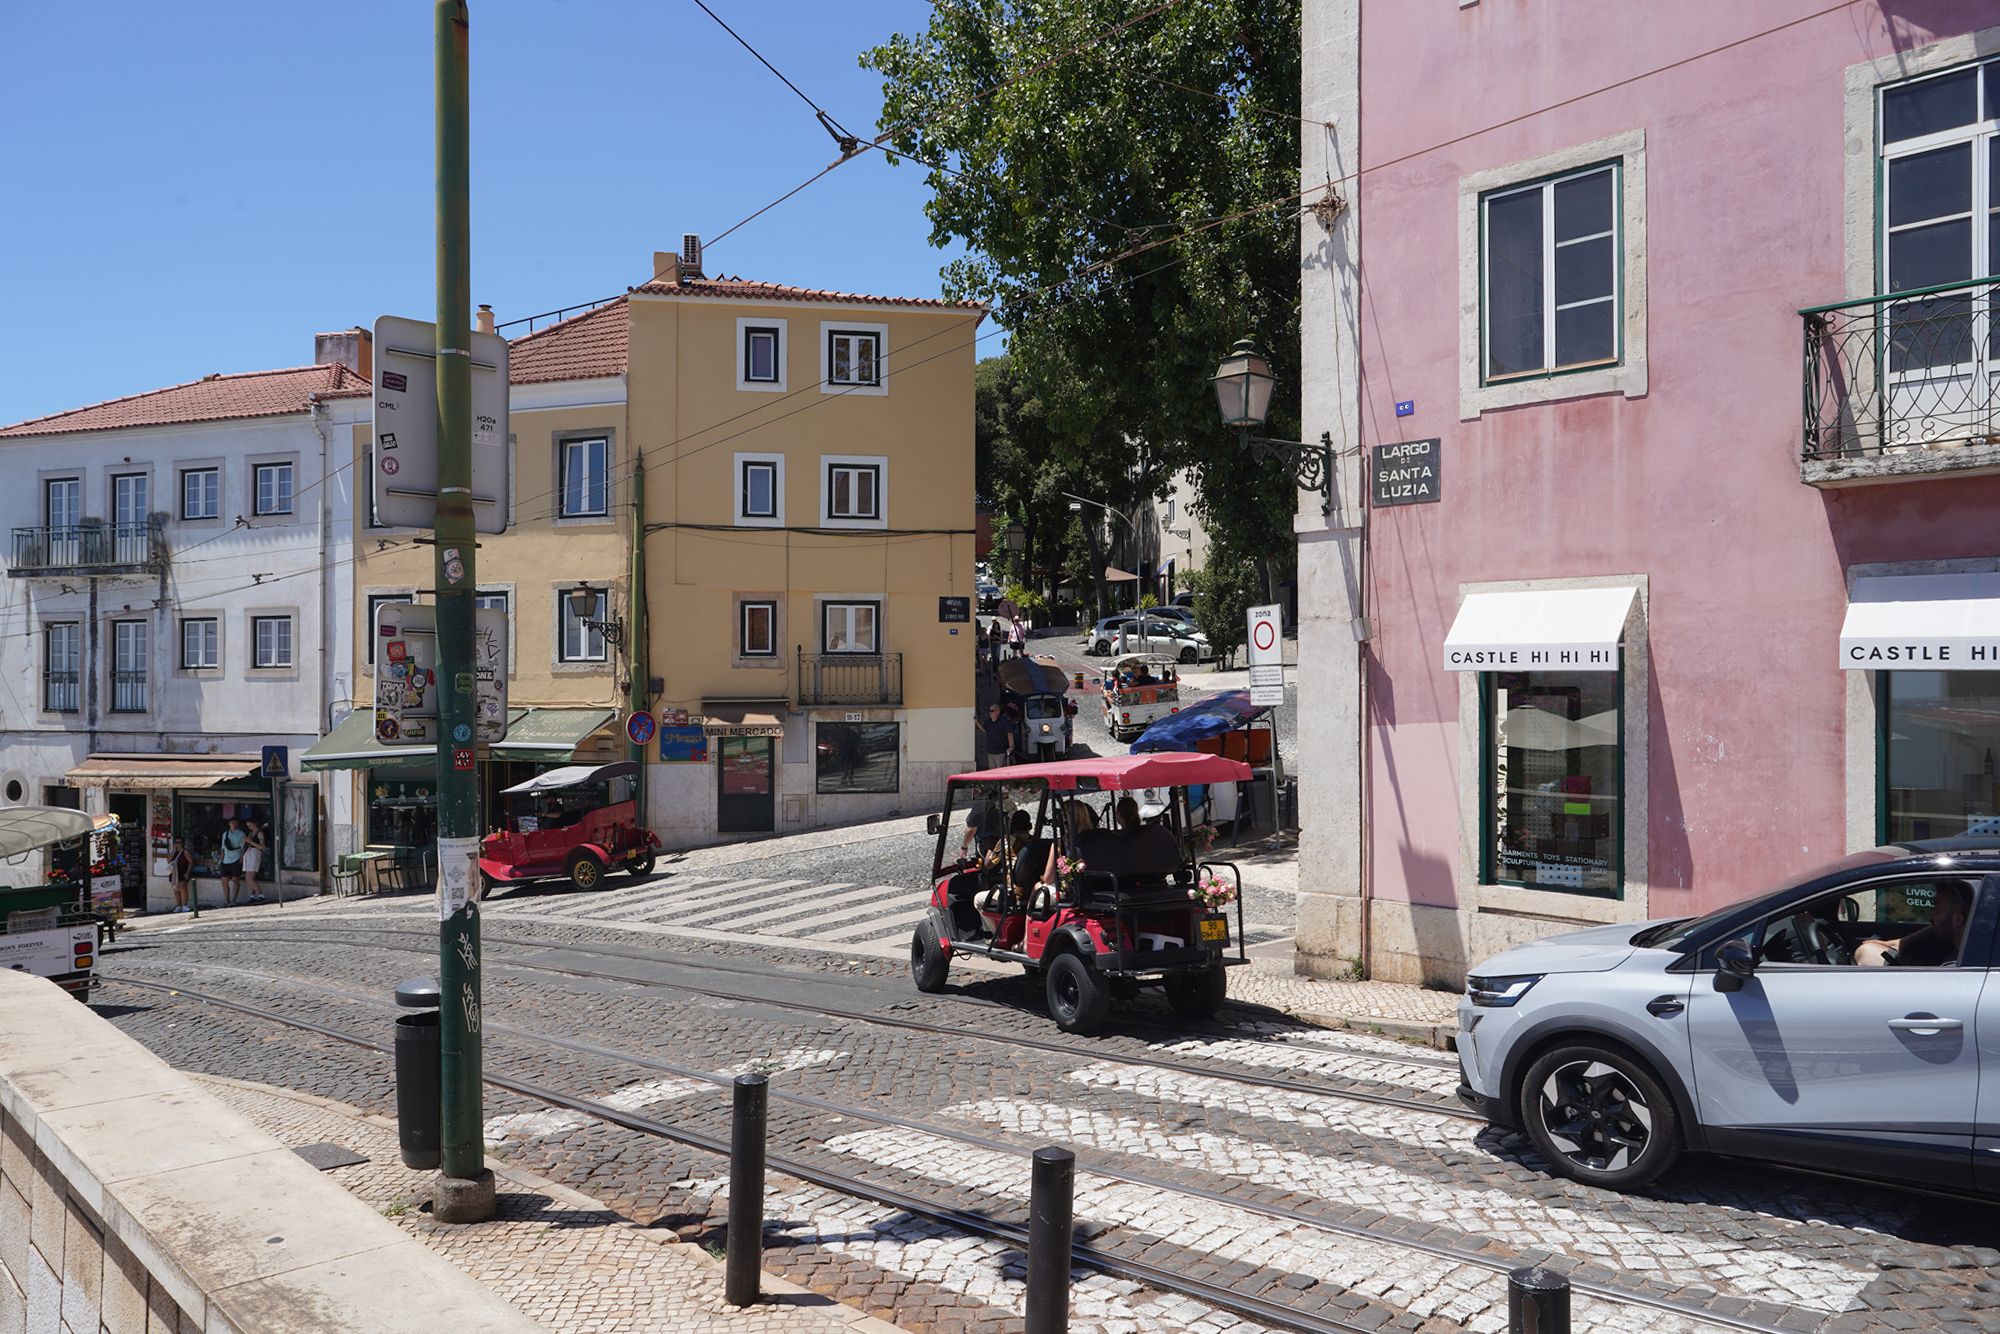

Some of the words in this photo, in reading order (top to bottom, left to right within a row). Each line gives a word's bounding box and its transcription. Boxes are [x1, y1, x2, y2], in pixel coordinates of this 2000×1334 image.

[379, 401, 397, 411] CML
[1381, 442, 1430, 459] LARGO
[1379, 466, 1432, 482] SANTA
[1381, 483, 1430, 498] LUZIA
[1255, 610, 1272, 618] zona
[1451, 651, 1518, 664] CASTLE
[1531, 651, 1549, 663] HI
[1560, 650, 1579, 663] HI
[1590, 650, 1609, 663] HI
[1851, 646, 1950, 660] CASTLE
[1971, 646, 1998, 660] HI
[705, 727, 727, 736] MINI
[729, 727, 782, 736] MERCADO
[1502, 849, 1538, 859] GARMENTS
[1543, 853, 1561, 861] TOYS
[1565, 855, 1609, 867] STATIONARY
[1906, 888, 1937, 898] LIVRO
[1905, 898, 1935, 908] GELA
